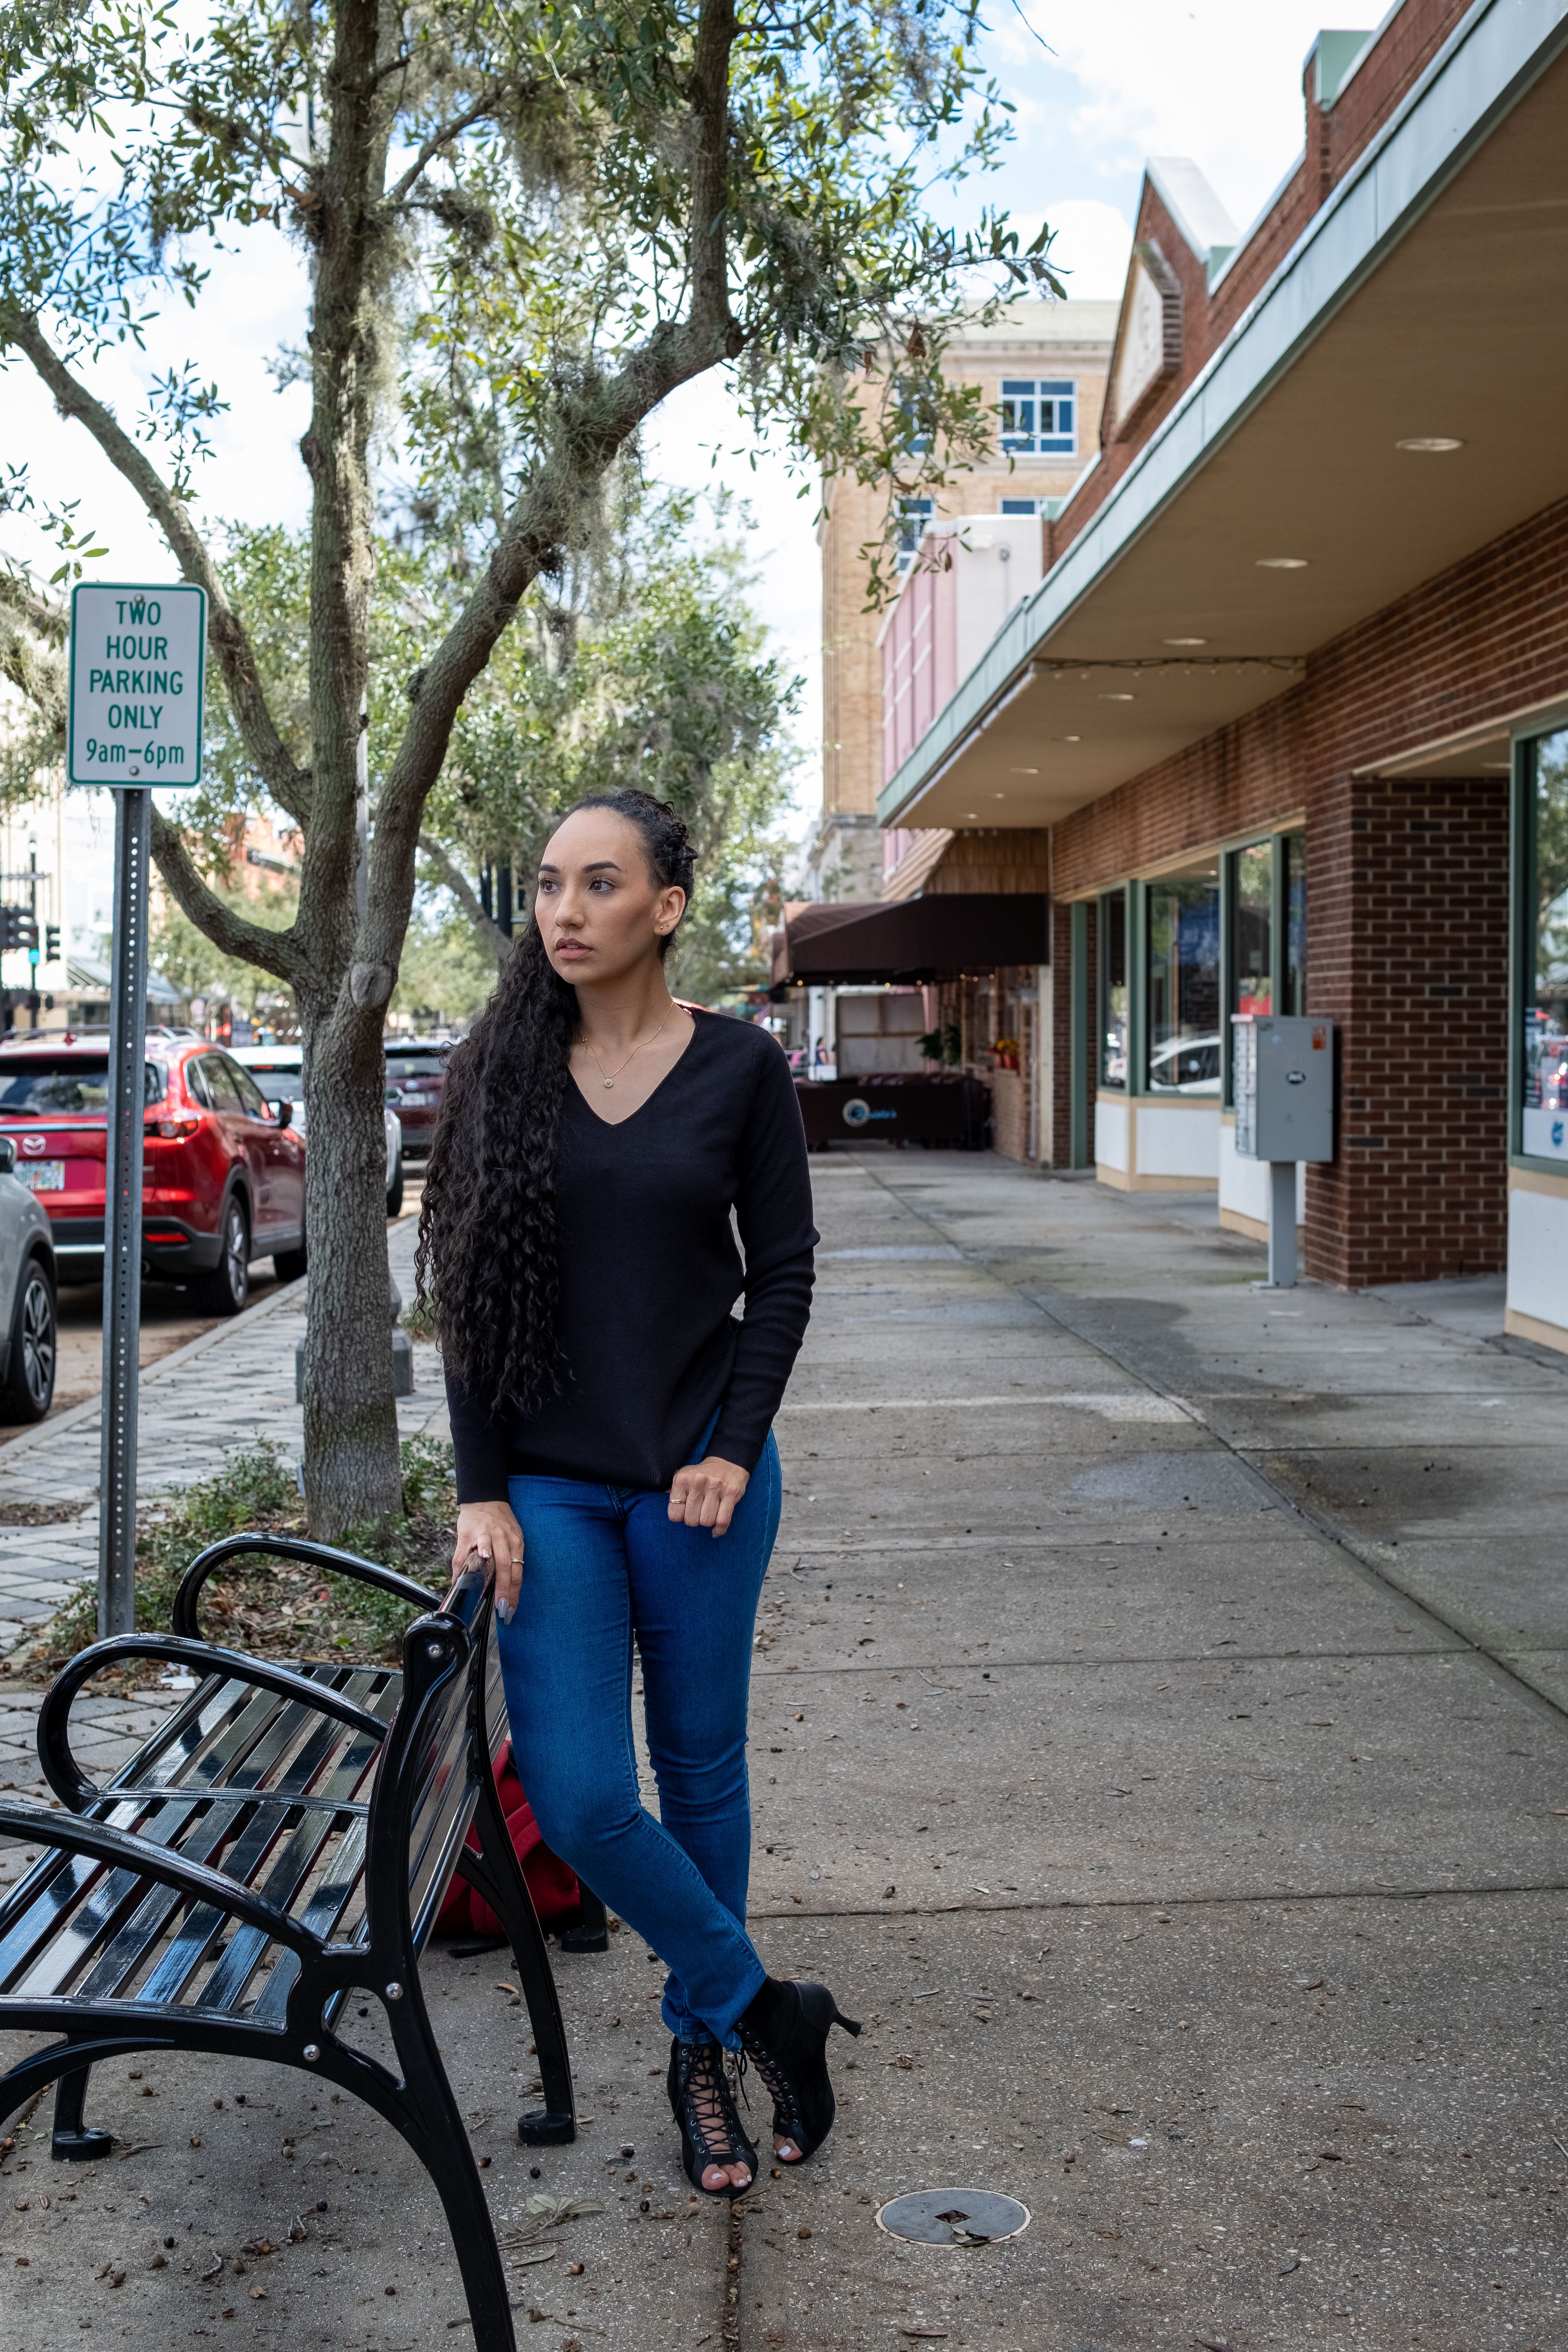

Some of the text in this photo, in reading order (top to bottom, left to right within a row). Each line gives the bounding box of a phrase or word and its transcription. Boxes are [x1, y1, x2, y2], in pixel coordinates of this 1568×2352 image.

[115, 601, 161, 626] TWO
[107, 635, 168, 660] HOUR
[90, 669, 183, 695] PARKING
[108, 704, 163, 729] ONLY
[86, 738, 184, 769] 9am-6pm
